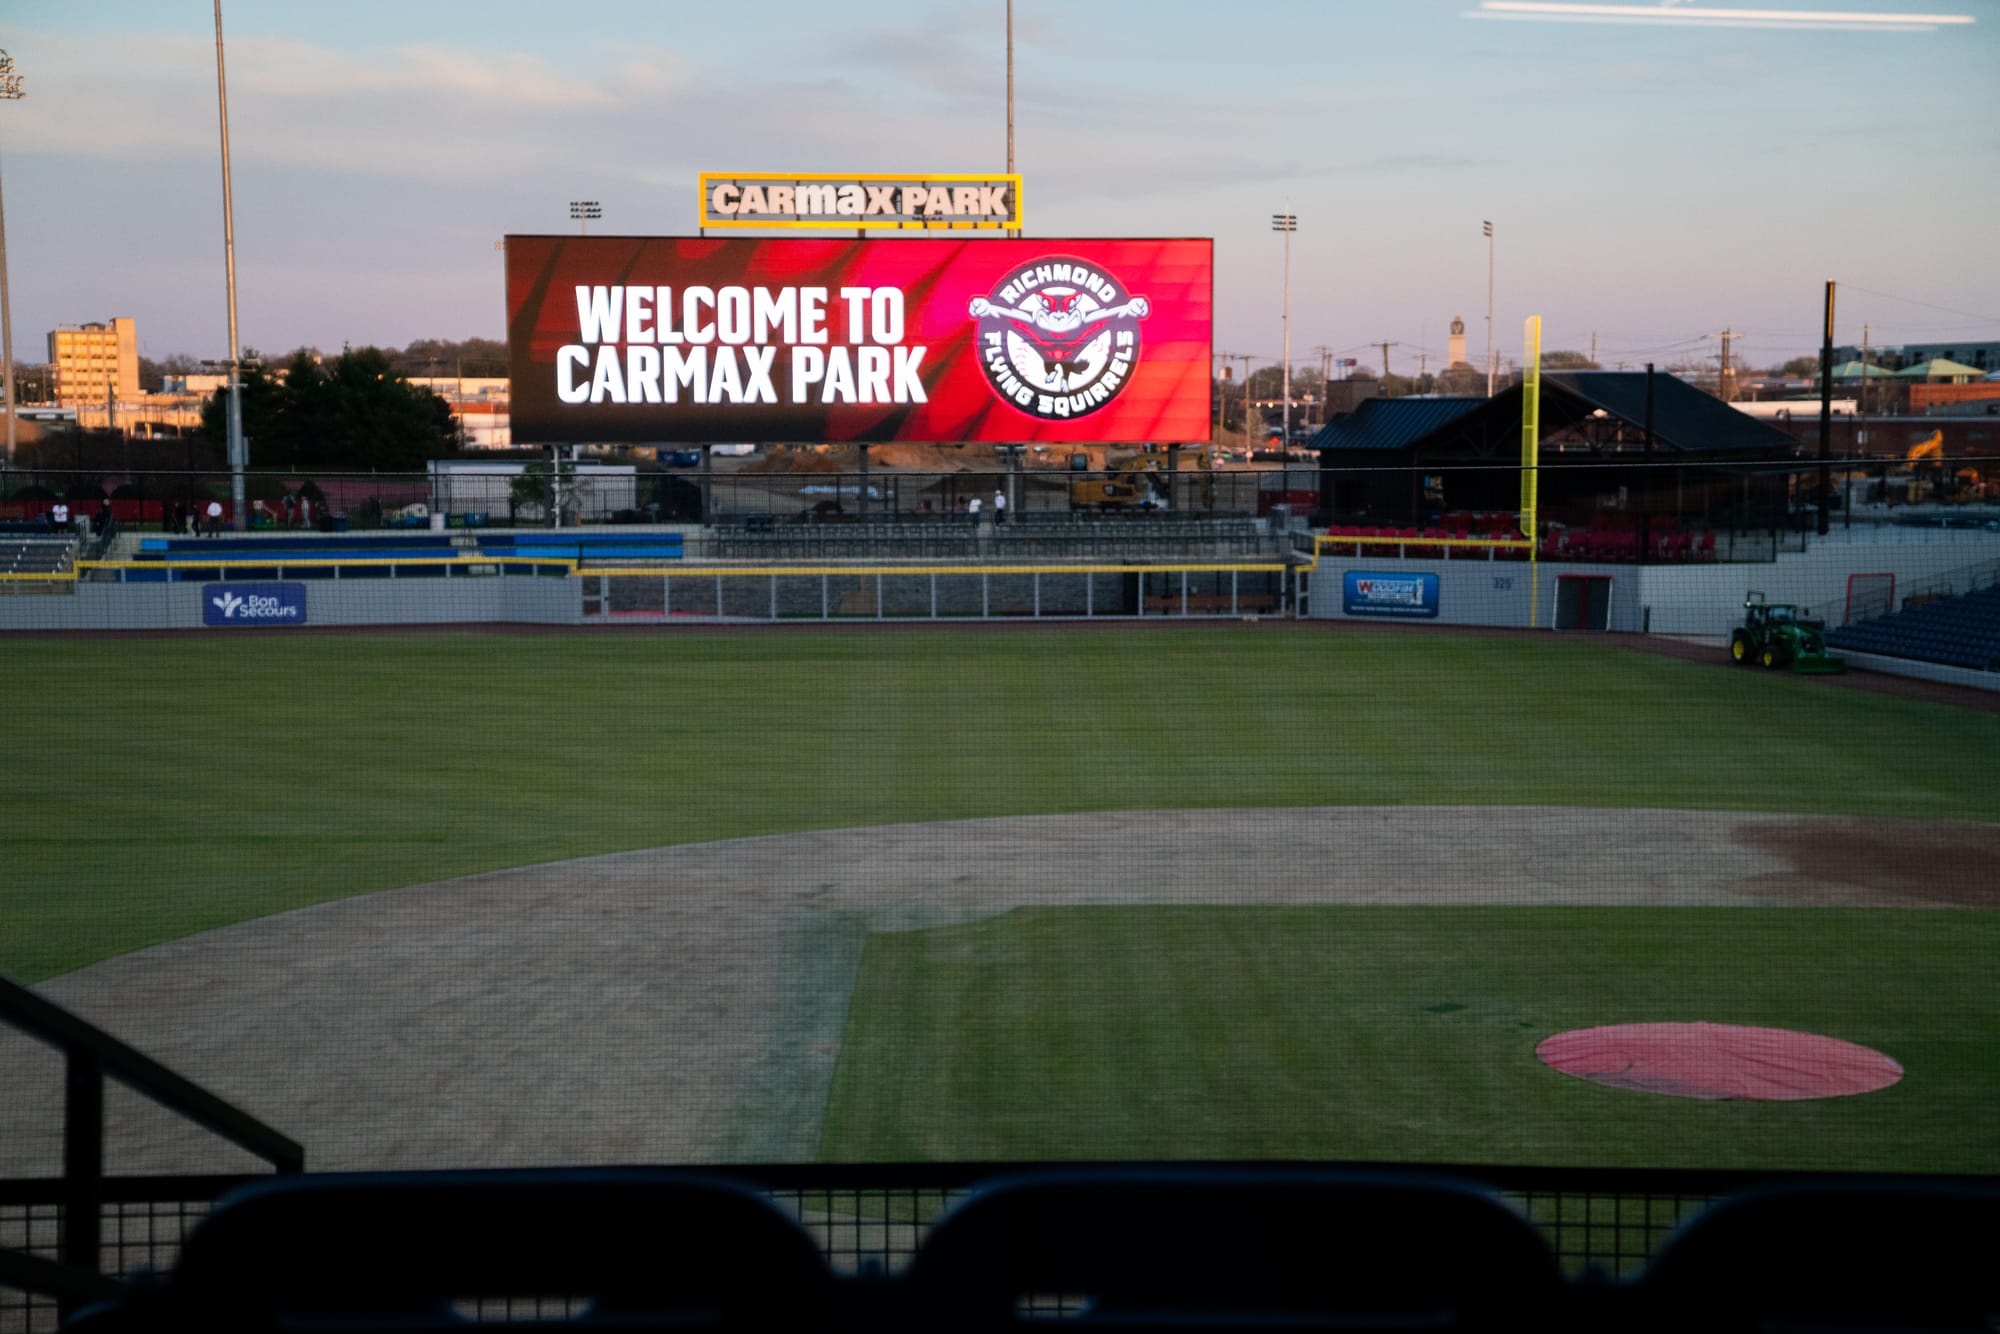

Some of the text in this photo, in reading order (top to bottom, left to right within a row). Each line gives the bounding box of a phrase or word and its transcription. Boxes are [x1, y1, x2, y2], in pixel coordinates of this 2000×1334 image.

[902, 185, 1009, 215] PARK
[999, 264, 1117, 304] RICHMOND
[575, 285, 905, 344] WELCOME TO
[556, 345, 928, 404] CARMAX PARK
[984, 330, 1134, 417] FLYING SQUIRRELS
[240, 605, 296, 617] Secours
[249, 595, 277, 607] Bon
